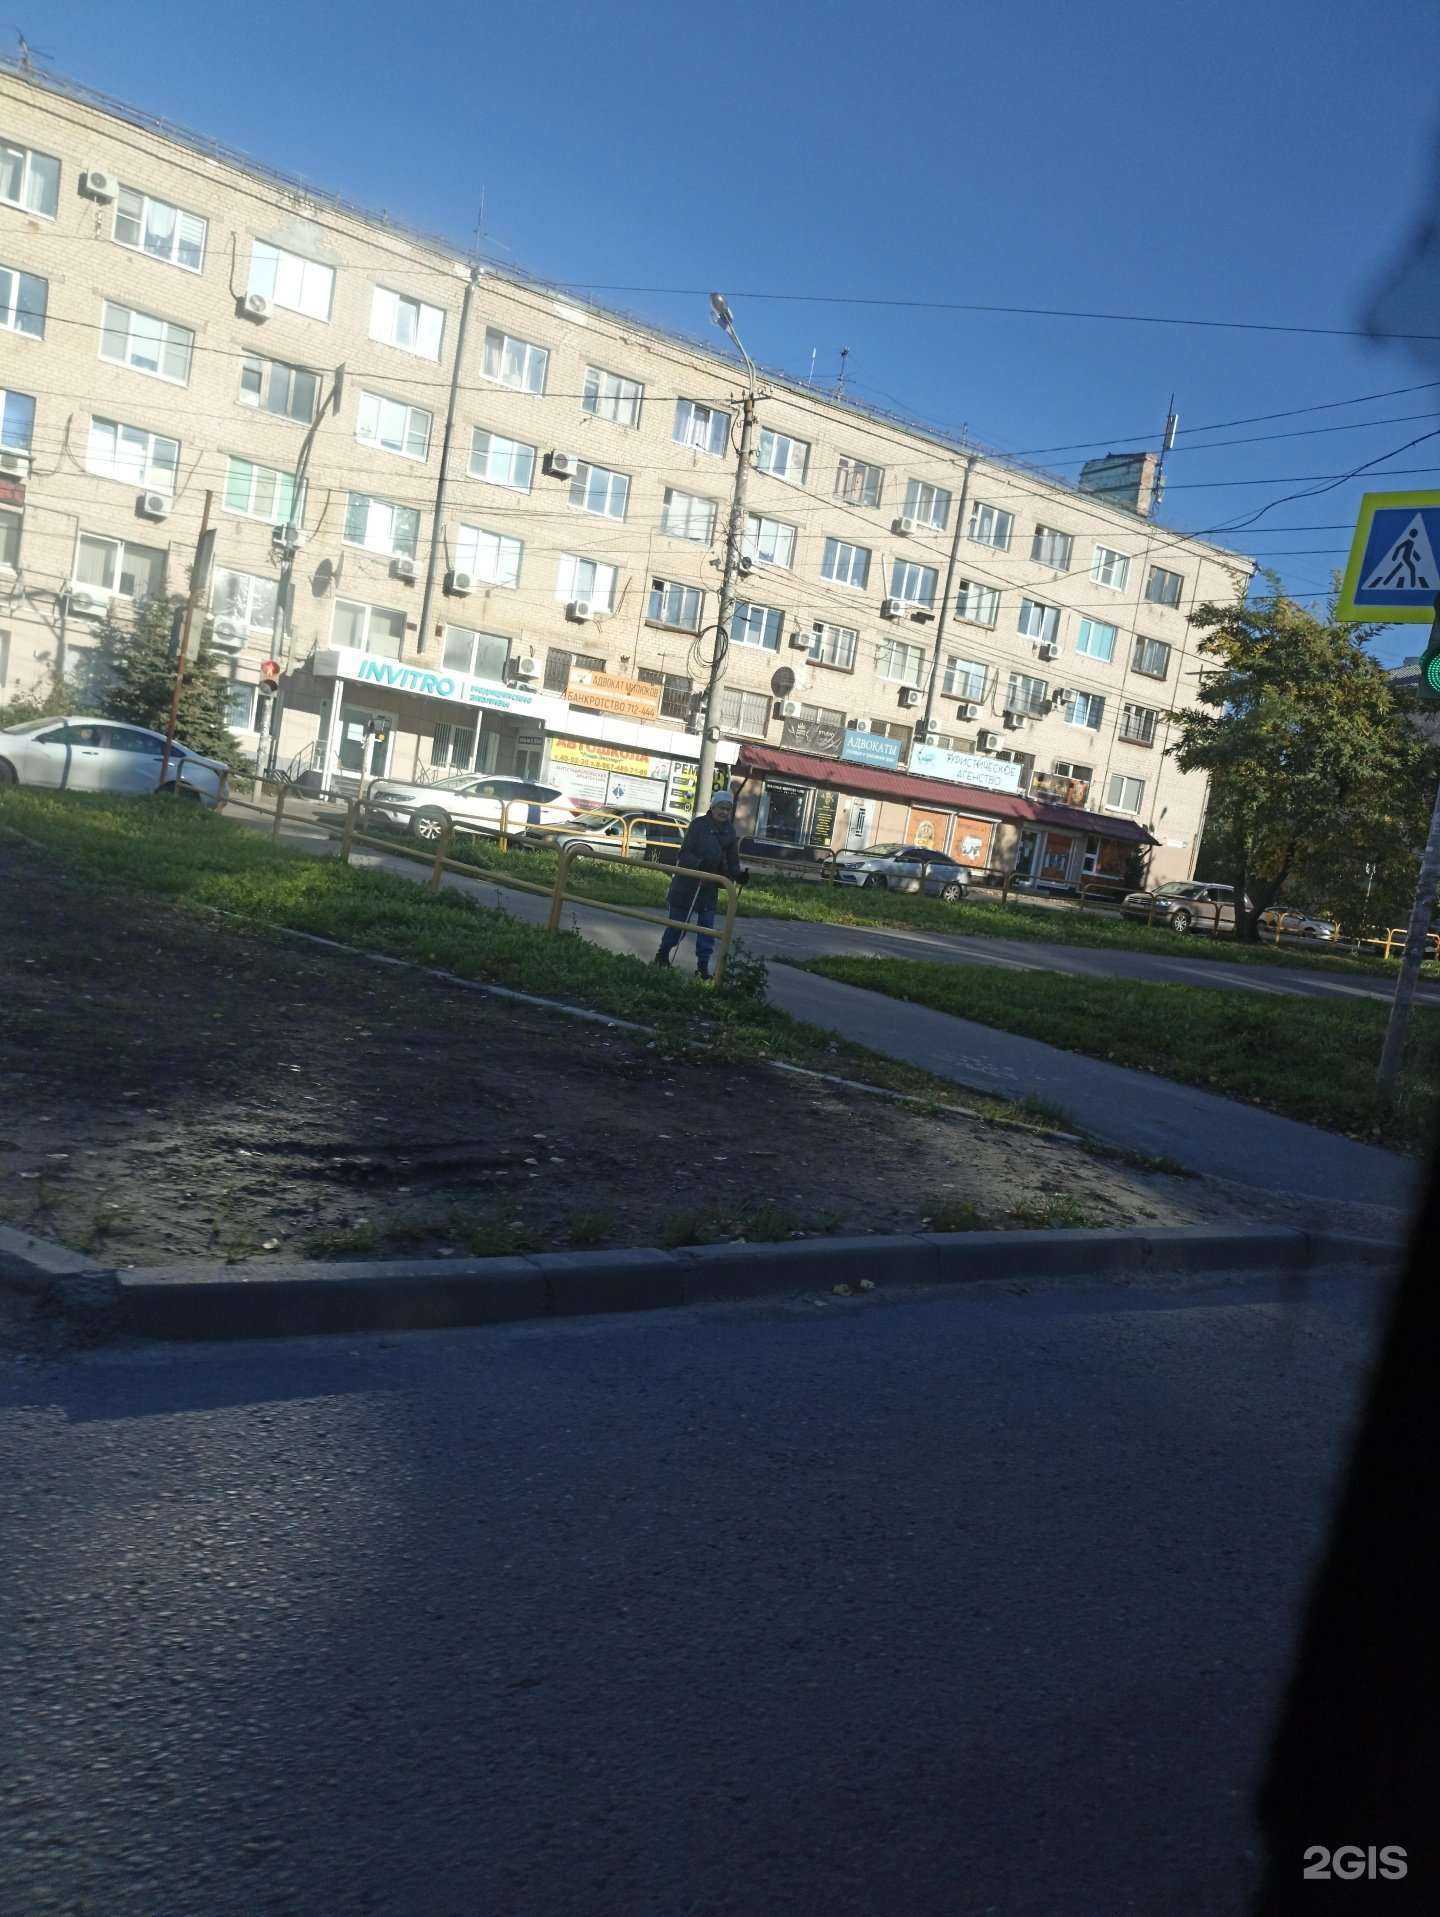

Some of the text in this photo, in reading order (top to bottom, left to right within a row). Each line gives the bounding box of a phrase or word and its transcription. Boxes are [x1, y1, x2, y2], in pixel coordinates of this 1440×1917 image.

[358, 660, 455, 696] INVITRO
[593, 676, 624, 690] АДВОКАТ
[567, 693, 655, 718] БАНКРОТСТВО 712-444
[847, 737, 898, 755] АДВОКАТЫ
